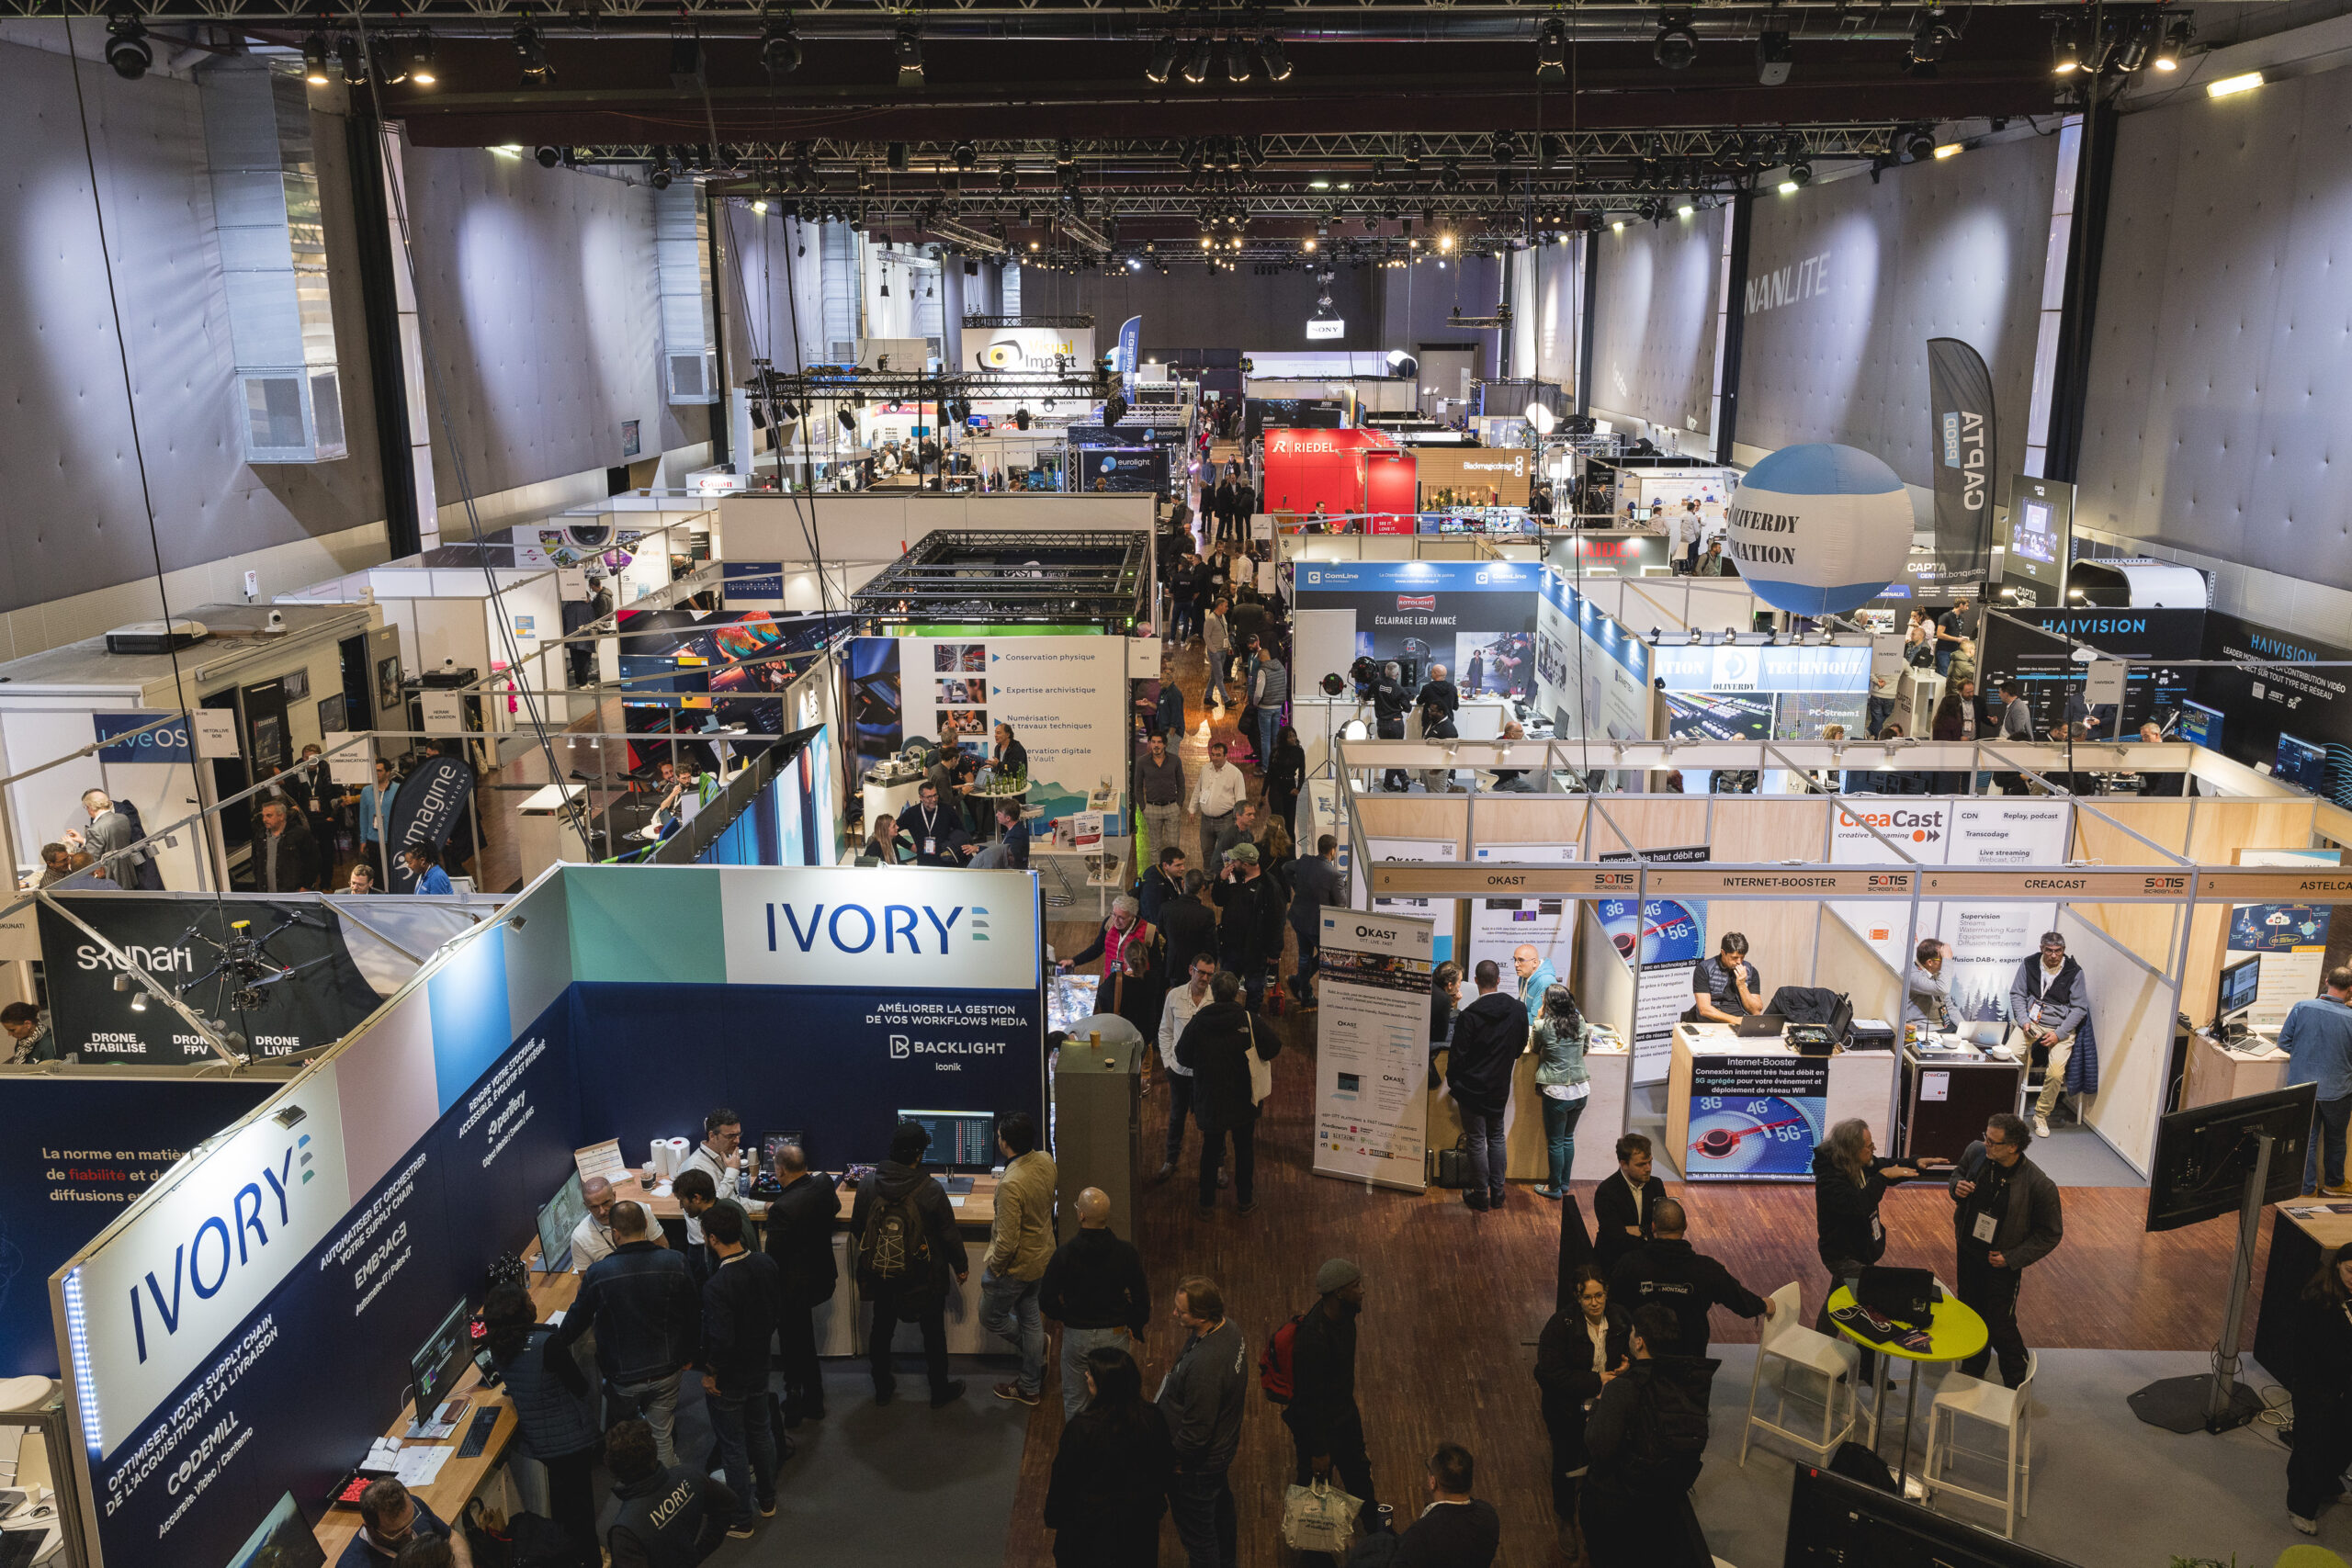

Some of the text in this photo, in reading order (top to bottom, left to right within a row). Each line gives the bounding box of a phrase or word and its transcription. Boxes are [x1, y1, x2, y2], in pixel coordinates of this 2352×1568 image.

[1744, 251, 1831, 316] NANLITE
[1029, 339, 1073, 355] Visual
[1125, 331, 1136, 397] EGRIPMENT
[1295, 442, 1335, 453] RIEDEL
[1117, 458, 1150, 467] eurolight
[700, 479, 732, 489] Canon
[1907, 562, 1947, 572] CAPTA
[2018, 586, 2037, 601] CAPTA
[1374, 615, 1457, 626] ÉCLAIRAGE LED AVANCÉ
[2042, 618, 2146, 634] HAIVISION
[1059, 653, 1095, 661] physique
[2251, 634, 2317, 668] HAIVISION
[1766, 660, 1863, 675] TECHNIQUE
[2223, 646, 2346, 694] LEADER CONTRIBUTION VIDÉO
[1006, 686, 1096, 694] Expertise archivistique
[1713, 682, 1755, 691] OLIVERDY
[2257, 668, 2334, 700] SUR TOUT TYPE DE RÉSEAU
[101, 728, 188, 748] LveOS
[402, 765, 457, 845] imagine
[430, 773, 468, 841] MMUNICATIONS
[2003, 812, 2029, 820] Replay,
[2030, 812, 2059, 821] podcast
[1965, 830, 2009, 839] Transcodage
[1653, 852, 1670, 862] haut
[1671, 850, 1693, 860] débit
[1996, 850, 2030, 858] streaming
[1384, 875, 1390, 884] 8
[1487, 875, 1526, 886] OKAST
[1657, 877, 1662, 886] 7
[1723, 877, 1836, 887] INTERNET-BOOSTER
[1931, 879, 1938, 887] 6
[2024, 879, 2086, 889] CREACAST
[1606, 902, 1624, 917] 3G
[1644, 903, 1662, 917] 4G
[765, 902, 963, 954] IVORY
[1355, 925, 1396, 940] OKAST
[1667, 923, 1689, 940] 5G
[1661, 960, 1688, 968] technologie
[1999, 956, 2023, 964] experti
[877, 1002, 1015, 1015] AMÉLIORER LA GESTION
[865, 1015, 1028, 1027] DE VOS WORKFLOWS MEDIA
[92, 1032, 137, 1043] DRONE
[173, 1034, 209, 1045] DRON
[255, 1036, 300, 1046] DRONE
[84, 1041, 147, 1054] STABILISÉ
[184, 1044, 209, 1055] FPV
[264, 1045, 293, 1055] LIVE
[914, 1042, 1006, 1055] BACKLIGHT
[935, 1062, 962, 1071] iconik
[1727, 1057, 1797, 1066] Internet-Booster
[469, 1037, 536, 1113] RENDRE VOTRE STOCKAGE
[1383, 1074, 1405, 1084] OKAST
[459, 1097, 493, 1139] ACCESSIBLE,
[493, 1069, 518, 1102] ÉVOLUTIF
[517, 1061, 526, 1075] ET
[1701, 1096, 1723, 1110] 3G
[1747, 1100, 1769, 1115] 4G
[1775, 1125, 1801, 1142] 5G
[42, 1147, 186, 1161] La norme en matièr
[46, 1168, 146, 1181] de fiabilité et
[50, 1189, 124, 1201] diffusions
[320, 1152, 427, 1271] AUTOMATISER ET ORCHESTRER
[340, 1181, 413, 1266] VOTRE SUPPLY CHAIN
[130, 1145, 293, 1366] IVORY
[1661, 1286, 1689, 1294] MONTAGE
[108, 1313, 273, 1492] OPTIMISER VOTRE SUPPLY CHAIN
[106, 1325, 279, 1517] DE L'ACQUISITION À LA LIVRAISON
[220, 1426, 254, 1466] Cantemo
[167, 1410, 239, 1496] CODEMILL
[650, 1482, 688, 1527] IVORY
